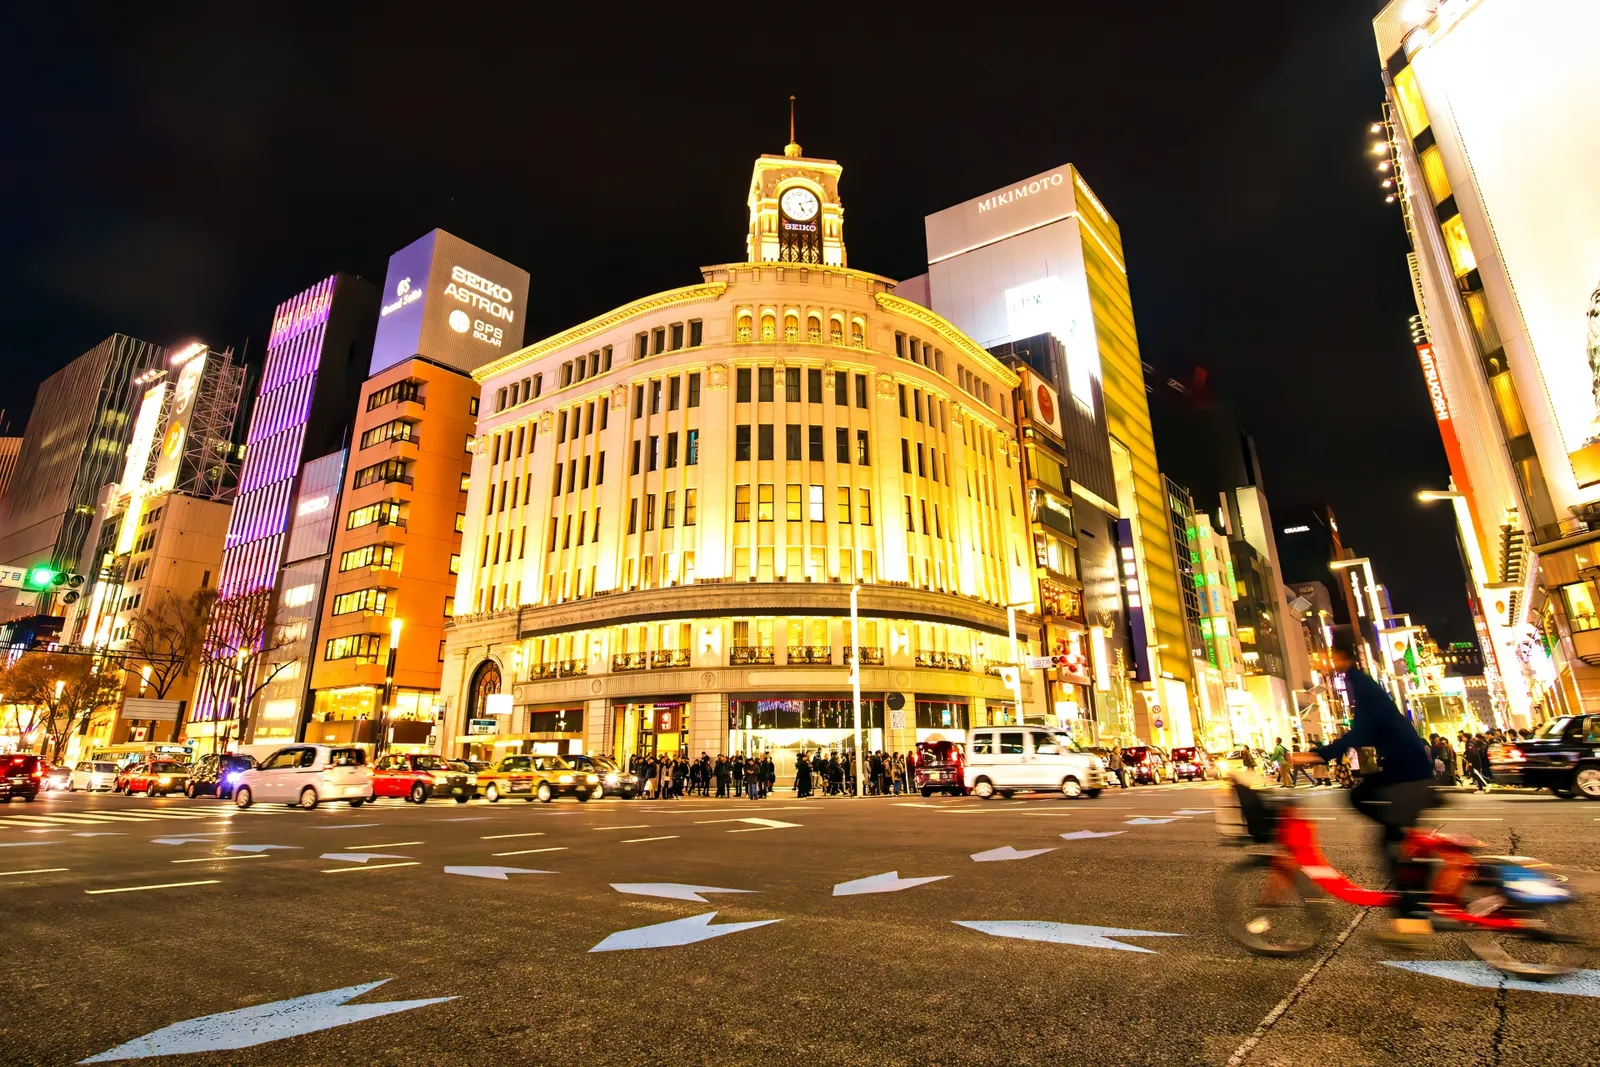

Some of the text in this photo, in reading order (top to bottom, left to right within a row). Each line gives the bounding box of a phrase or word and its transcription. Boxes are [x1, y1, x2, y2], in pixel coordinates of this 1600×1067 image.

[977, 173, 1063, 214] MIKIMOTO
[784, 223, 817, 232] SEIKO
[444, 282, 514, 323] ASTRON
[450, 265, 513, 304] SEIKO
[473, 319, 503, 340] GPS
[473, 330, 502, 348] SOLAR
[1419, 348, 1449, 420] MITSUKOSHI
